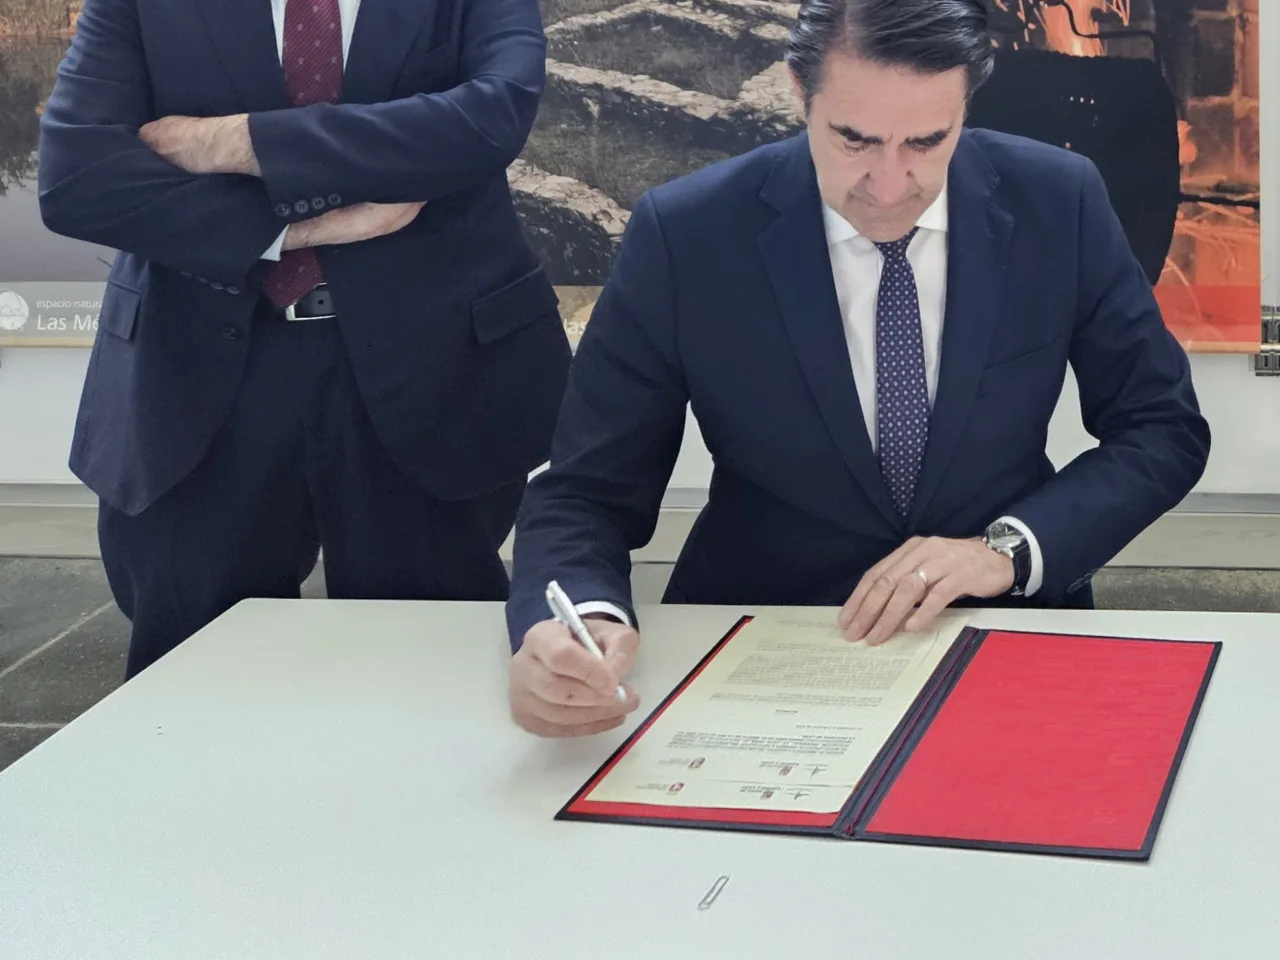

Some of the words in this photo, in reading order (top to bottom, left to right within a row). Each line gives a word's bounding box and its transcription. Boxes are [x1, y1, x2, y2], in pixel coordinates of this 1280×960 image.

[36, 300, 72, 309] espacio
[37, 314, 67, 331] Las
[73, 313, 100, 331] Mé
